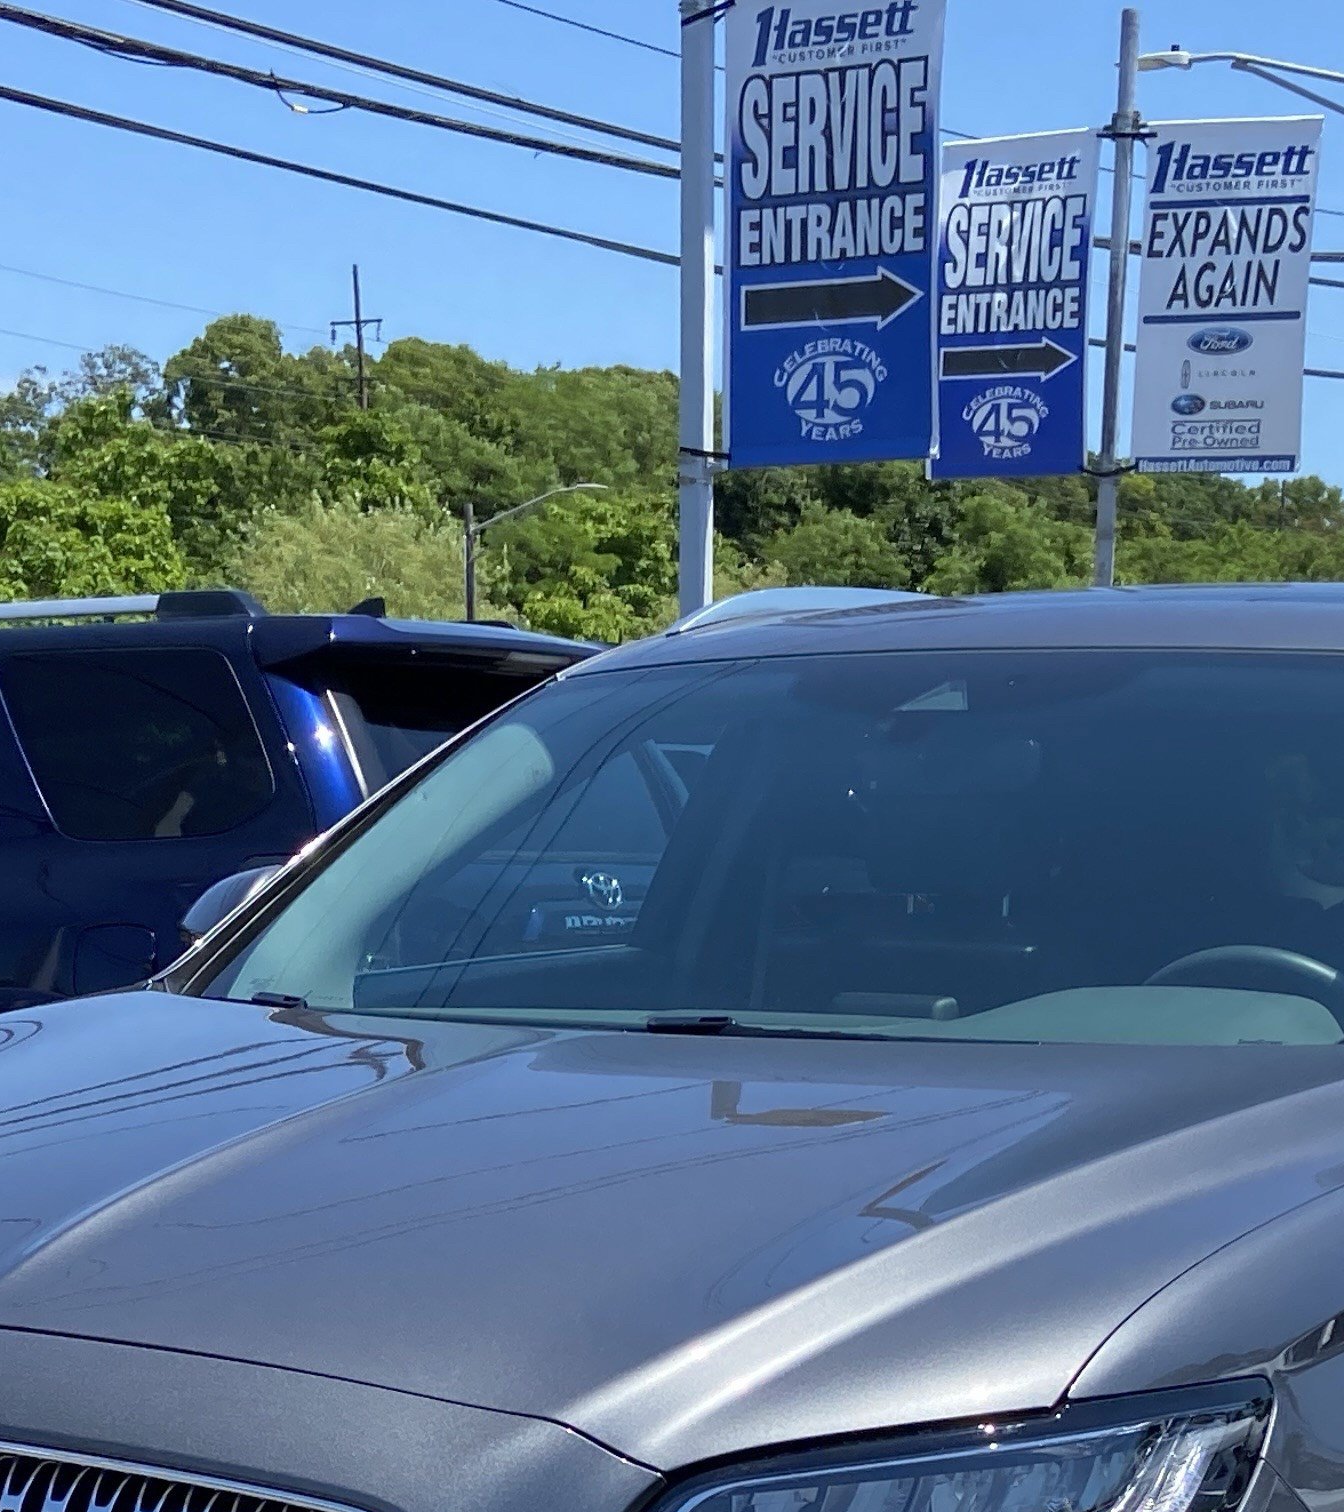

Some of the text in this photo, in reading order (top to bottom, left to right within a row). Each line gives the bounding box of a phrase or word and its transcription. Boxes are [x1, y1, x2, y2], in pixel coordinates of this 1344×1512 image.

[739, 55, 929, 200] SERVICE
[739, 192, 926, 267] ENTRANCE
[944, 193, 1088, 289] SERVICE
[1147, 205, 1310, 258] EXPANDS
[1166, 258, 1281, 309] AGAIN
[940, 286, 1081, 336] ENTRANCE
[773, 337, 888, 388] CELEBRATING
[1200, 331, 1239, 351] Ford
[789, 358, 873, 418] 45
[962, 385, 1050, 421] CELEBRATING
[1209, 400, 1264, 410] SUBARU
[800, 418, 864, 441] YEARS
[975, 399, 1034, 444] 45
[1171, 421, 1261, 436] Certified
[982, 442, 1032, 459] YEARS
